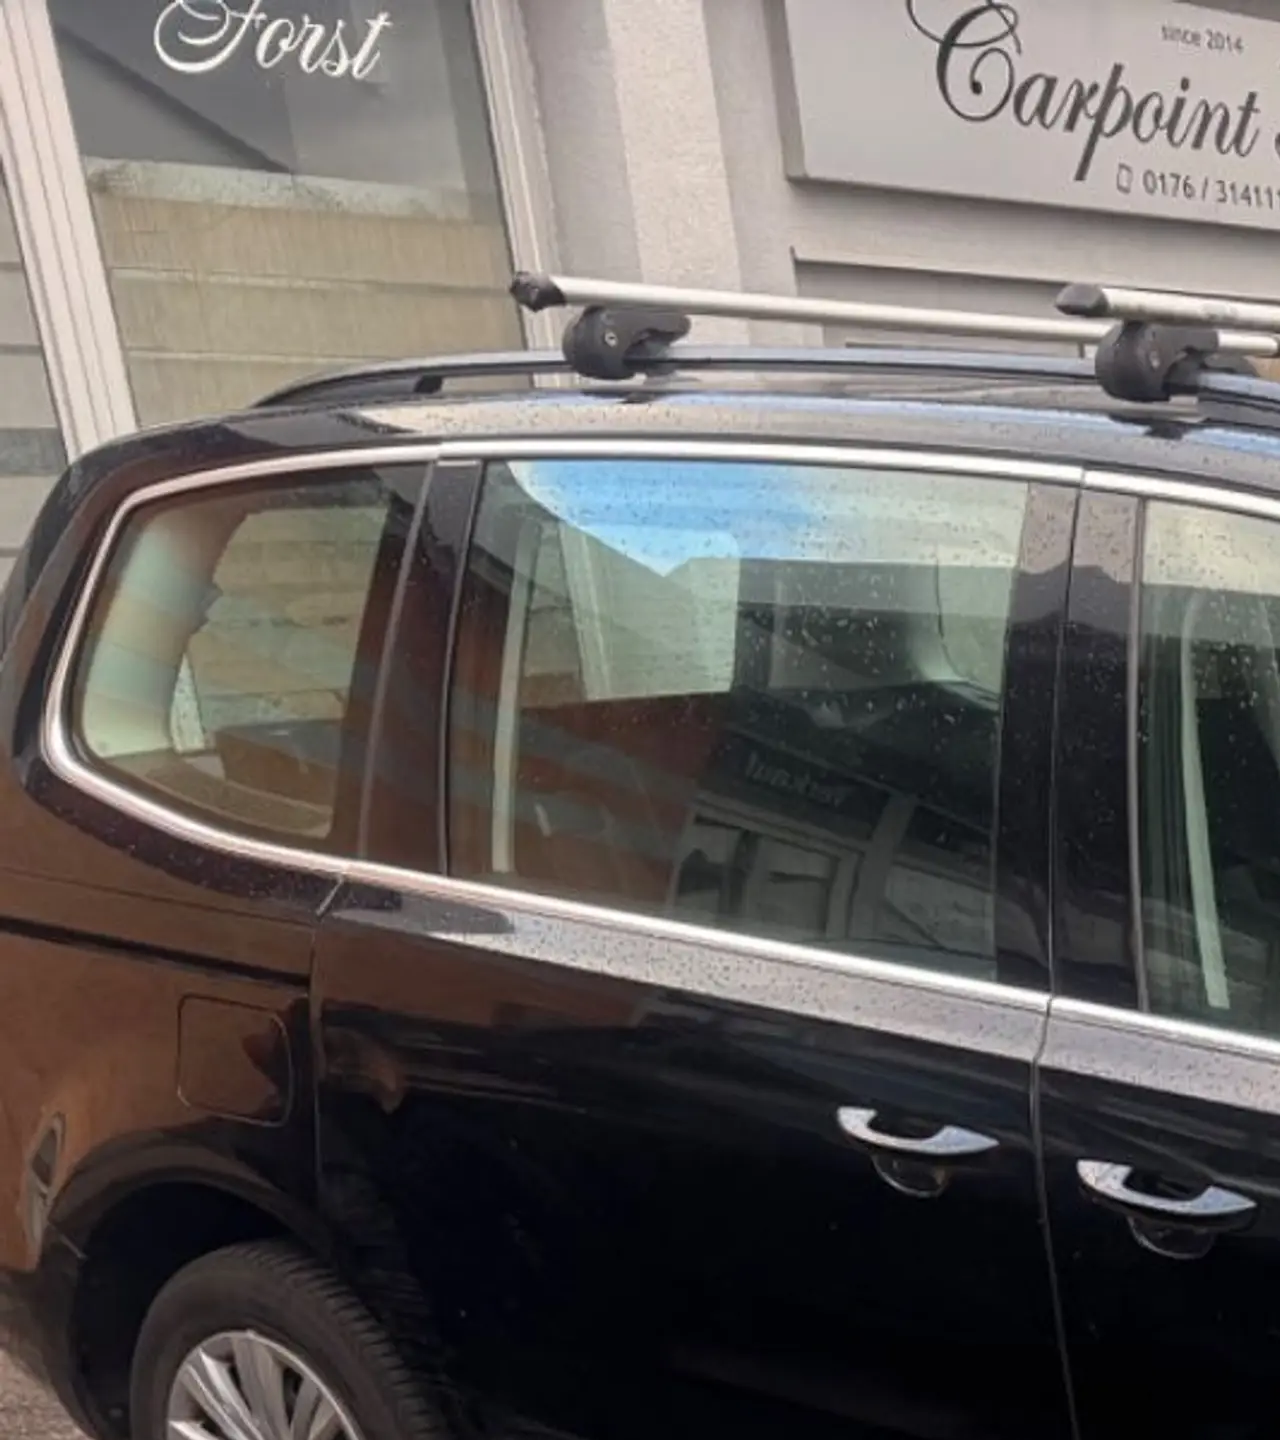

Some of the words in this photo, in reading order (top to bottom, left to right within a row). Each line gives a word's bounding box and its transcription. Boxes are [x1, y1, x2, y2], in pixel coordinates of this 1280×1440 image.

[154, 0, 392, 79] Forst
[1160, 24, 1201, 46] since
[1205, 28, 1245, 53] 2014
[906, 0, 1260, 181] Carpoint
[1142, 168, 1196, 200] 0176
[1201, 176, 1210, 201] /
